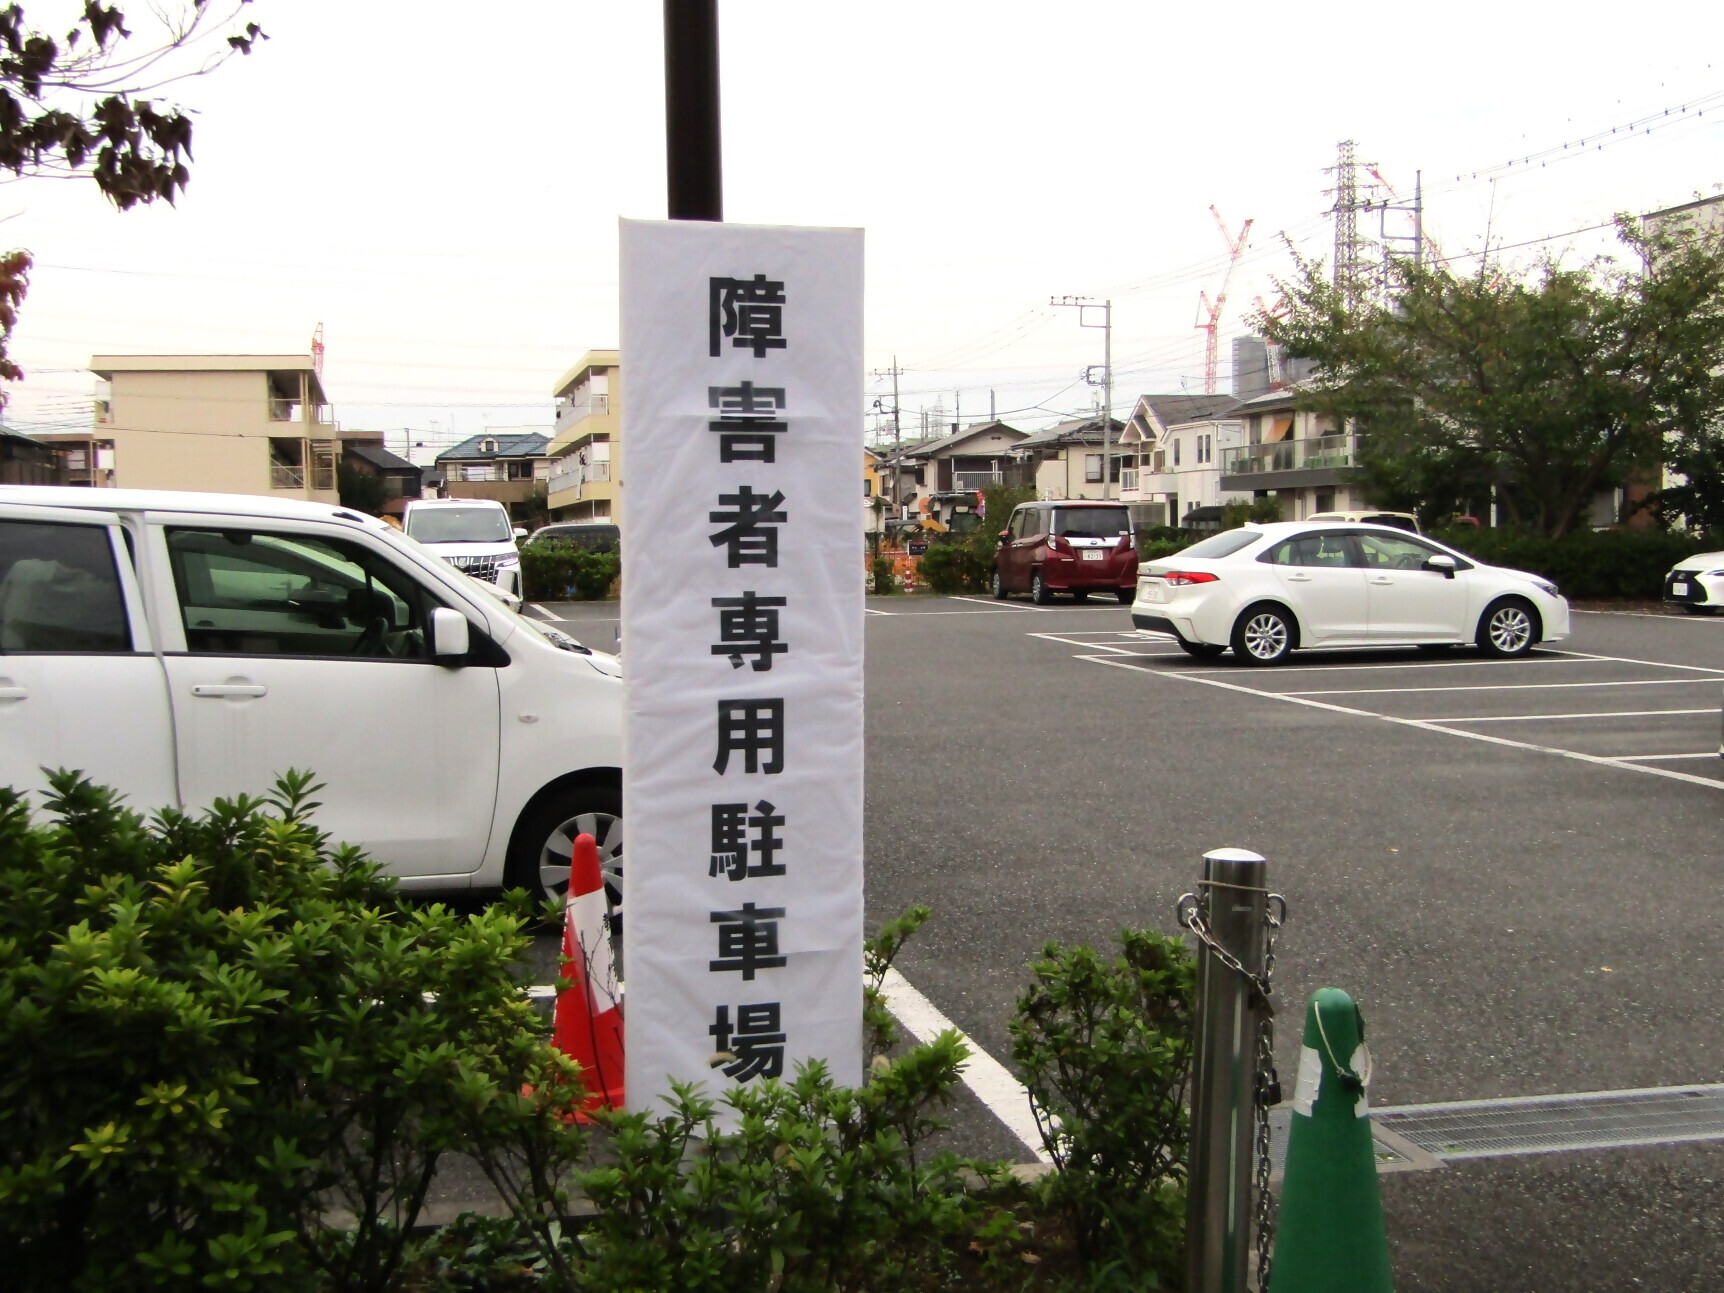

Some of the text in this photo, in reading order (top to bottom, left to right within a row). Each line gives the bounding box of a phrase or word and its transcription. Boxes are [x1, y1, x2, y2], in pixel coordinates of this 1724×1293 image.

[708, 274, 788, 1083] 障害者専用駐車場
